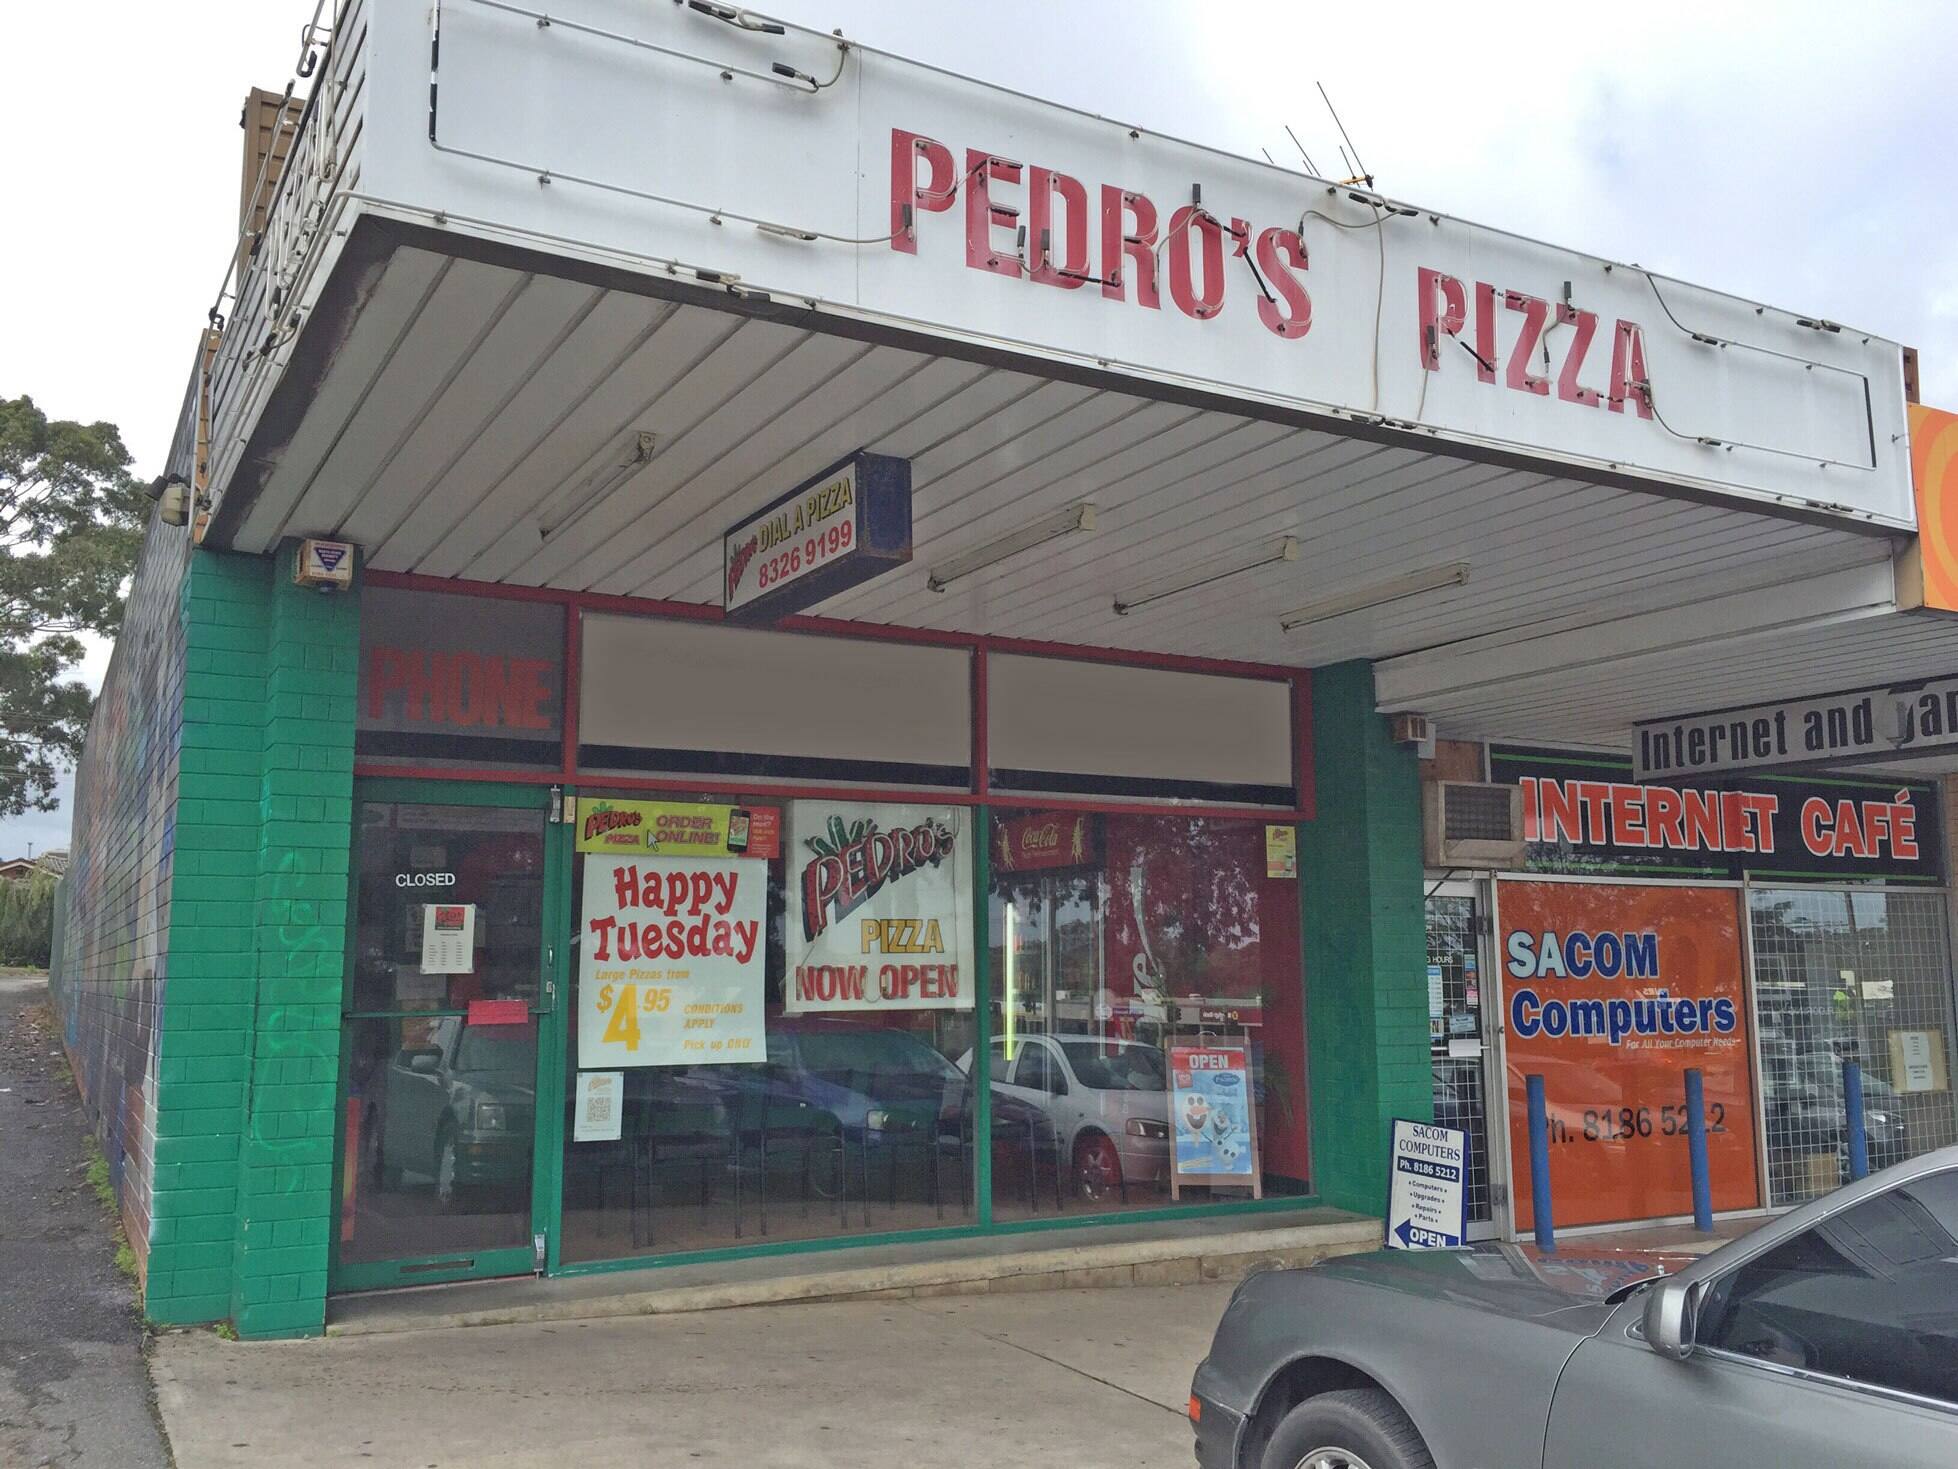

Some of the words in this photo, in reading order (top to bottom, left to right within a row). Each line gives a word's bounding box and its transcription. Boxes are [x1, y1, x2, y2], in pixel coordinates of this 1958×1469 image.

[891, 127, 1312, 339] PEDRO'S
[1418, 266, 1653, 420] PIZZA
[759, 512, 791, 552] DIAL
[794, 505, 805, 535] A
[807, 477, 853, 527] PIZZA
[759, 547, 800, 588] 8326
[805, 519, 852, 565] 9199
[368, 646, 554, 729] PHONE
[1641, 710, 1788, 771] Internet
[1803, 698, 1874, 751] and
[656, 814, 713, 829] ORDER
[1519, 777, 1778, 853] INTERNET
[1800, 787, 1919, 860] CAFÉ
[395, 872, 456, 887] CLOSED
[613, 865, 739, 916] Happy
[590, 913, 759, 965] Tuesday
[861, 918, 945, 954] PIZZA
[1432, 955, 1453, 964] HOURS
[1507, 930, 1660, 979] SACOM
[595, 969, 625, 981] Large
[795, 964, 868, 1001] NOW
[879, 964, 960, 1000] OPEN
[1511, 988, 1737, 1046] Computers
[1674, 1037, 1712, 1049] Computer
[1189, 1054, 1229, 1069] OPEN
[1412, 1125, 1449, 1142] SACOM
[1547, 1111, 1575, 1143] h.
[1662, 1102, 1726, 1137] 522
[1399, 1139, 1460, 1161] COMPUTERS
[1400, 1159, 1412, 1170] Ph.
[1413, 1162, 1434, 1175] 8186
[1435, 1166, 1457, 1180] 5212
[1412, 1181, 1443, 1193] Computers
[1409, 1228, 1447, 1247] OPEN
